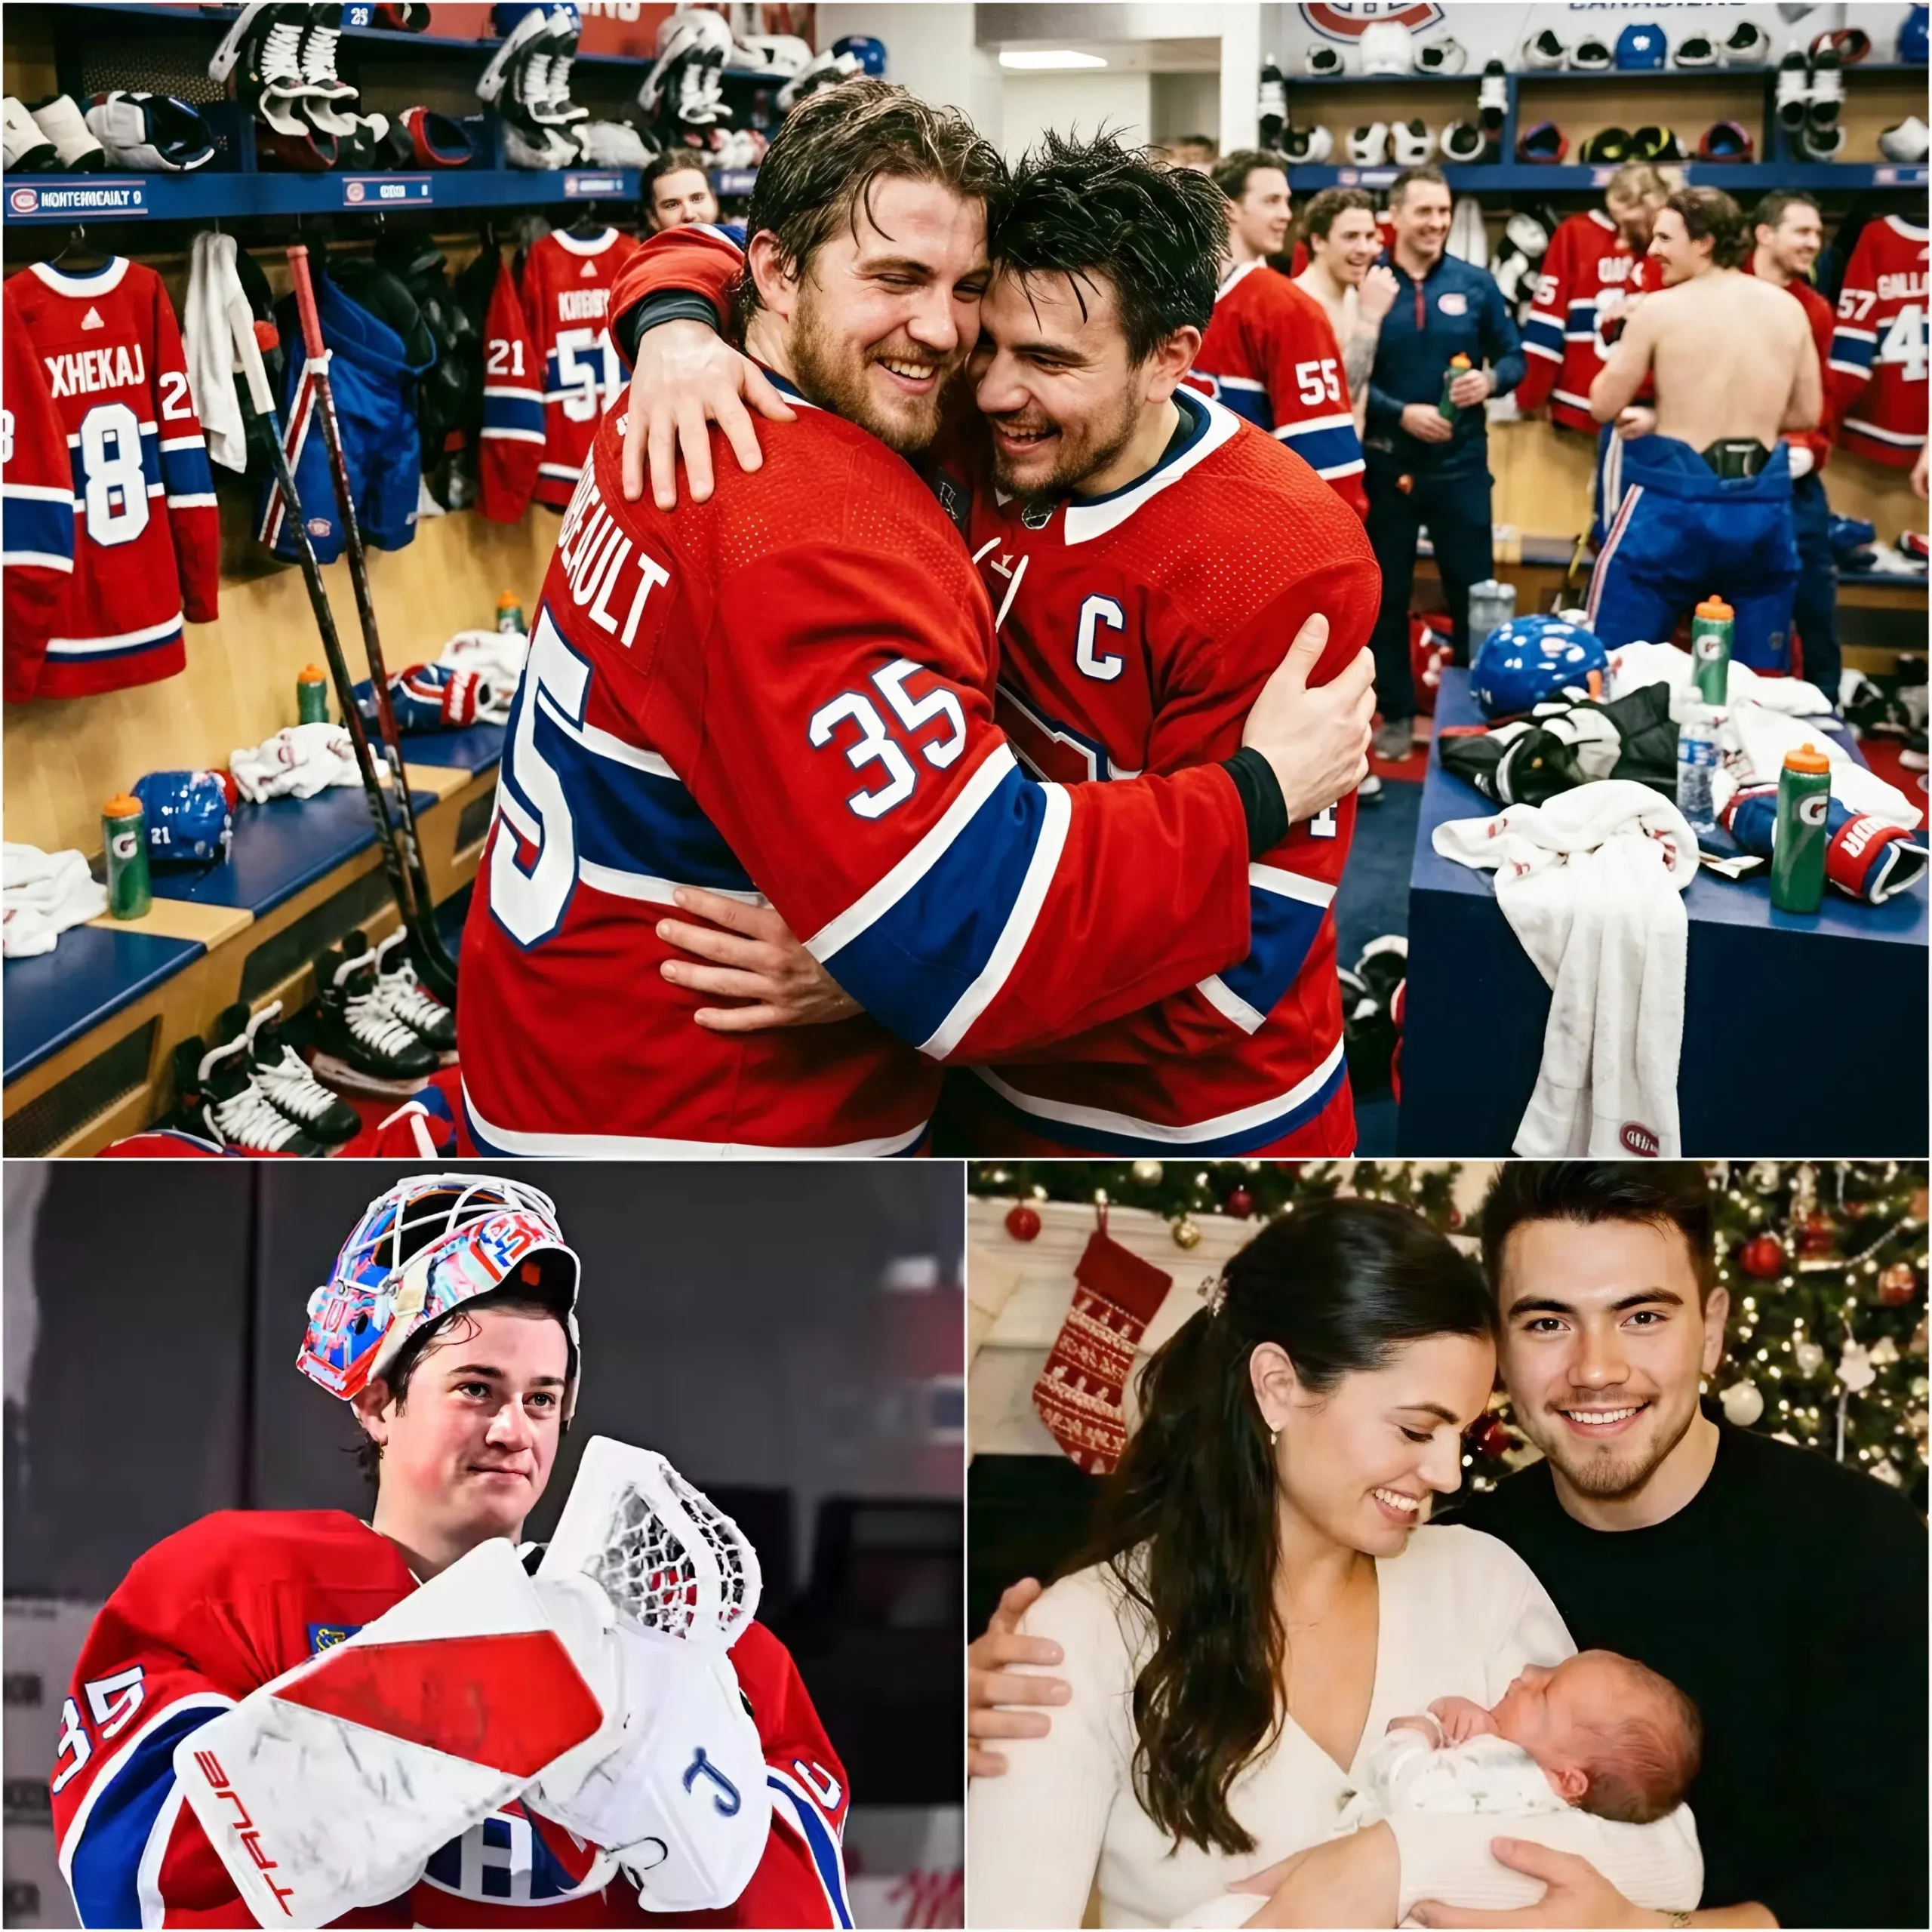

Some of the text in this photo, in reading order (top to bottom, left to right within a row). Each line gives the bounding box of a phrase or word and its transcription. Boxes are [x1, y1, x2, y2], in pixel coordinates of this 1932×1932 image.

[1836, 288, 1877, 321] 57
[44, 343, 146, 398] XHEKAJ
[487, 339, 525, 377] 21
[555, 327, 621, 423] 51
[1295, 358, 1340, 406] 55
[79, 401, 150, 547] 8
[1075, 592, 1126, 682] C
[807, 657, 967, 820] 35
[150, 826, 171, 844] 21
[1799, 795, 1828, 826] G
[51, 1664, 146, 1795] 35
[193, 1750, 294, 1917] TRUE
